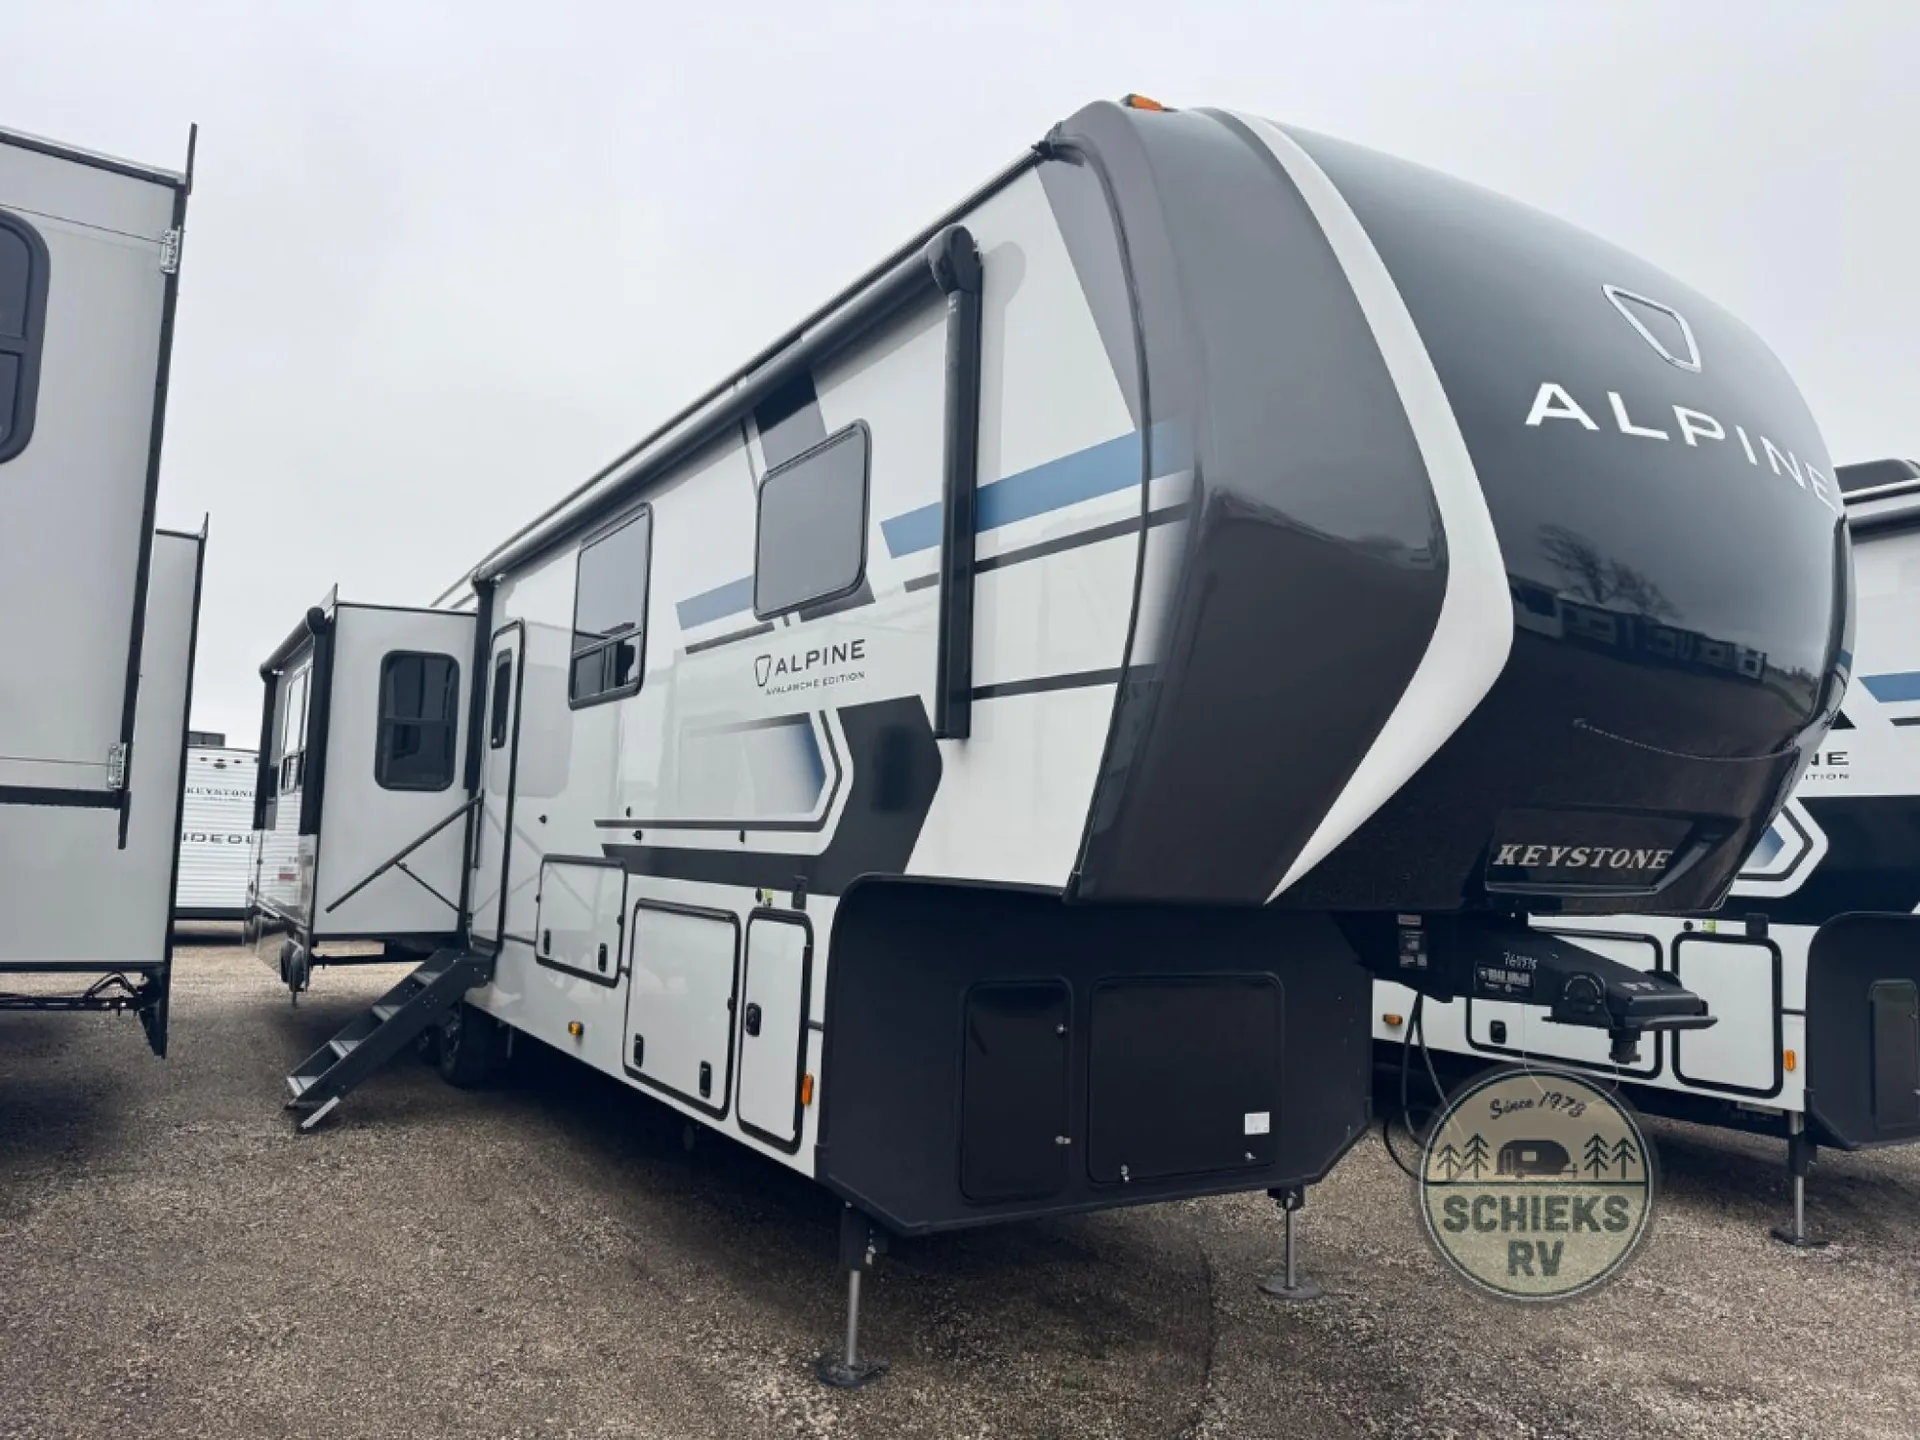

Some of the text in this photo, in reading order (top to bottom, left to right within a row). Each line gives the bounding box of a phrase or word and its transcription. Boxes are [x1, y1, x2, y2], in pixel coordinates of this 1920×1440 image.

[1525, 381, 1838, 513] ALPINE
[775, 638, 866, 675] ALPINE
[765, 671, 866, 696] AVALANCHE EDITION
[1493, 843, 1674, 870] KEYSTONE
